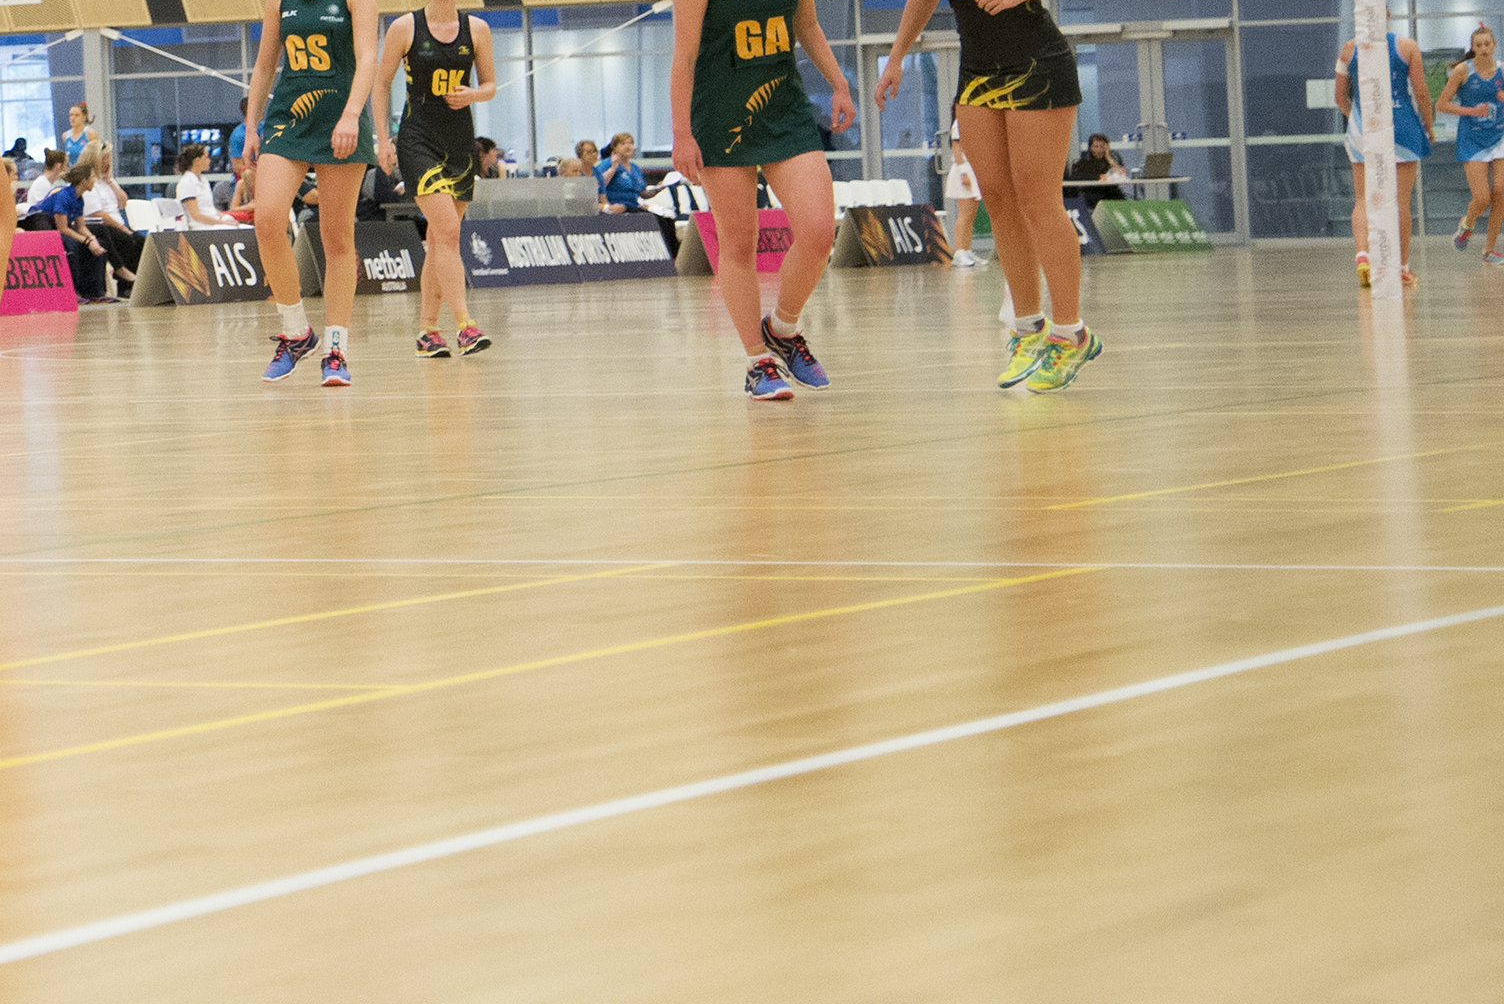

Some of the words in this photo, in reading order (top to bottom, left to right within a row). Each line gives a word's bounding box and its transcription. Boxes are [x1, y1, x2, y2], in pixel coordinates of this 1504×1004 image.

[285, 34, 331, 71] GS
[734, 16, 791, 60] GA
[431, 68, 465, 97] GK
[887, 216, 924, 254] AIS
[208, 242, 259, 288] AIS
[363, 248, 416, 281] netball
